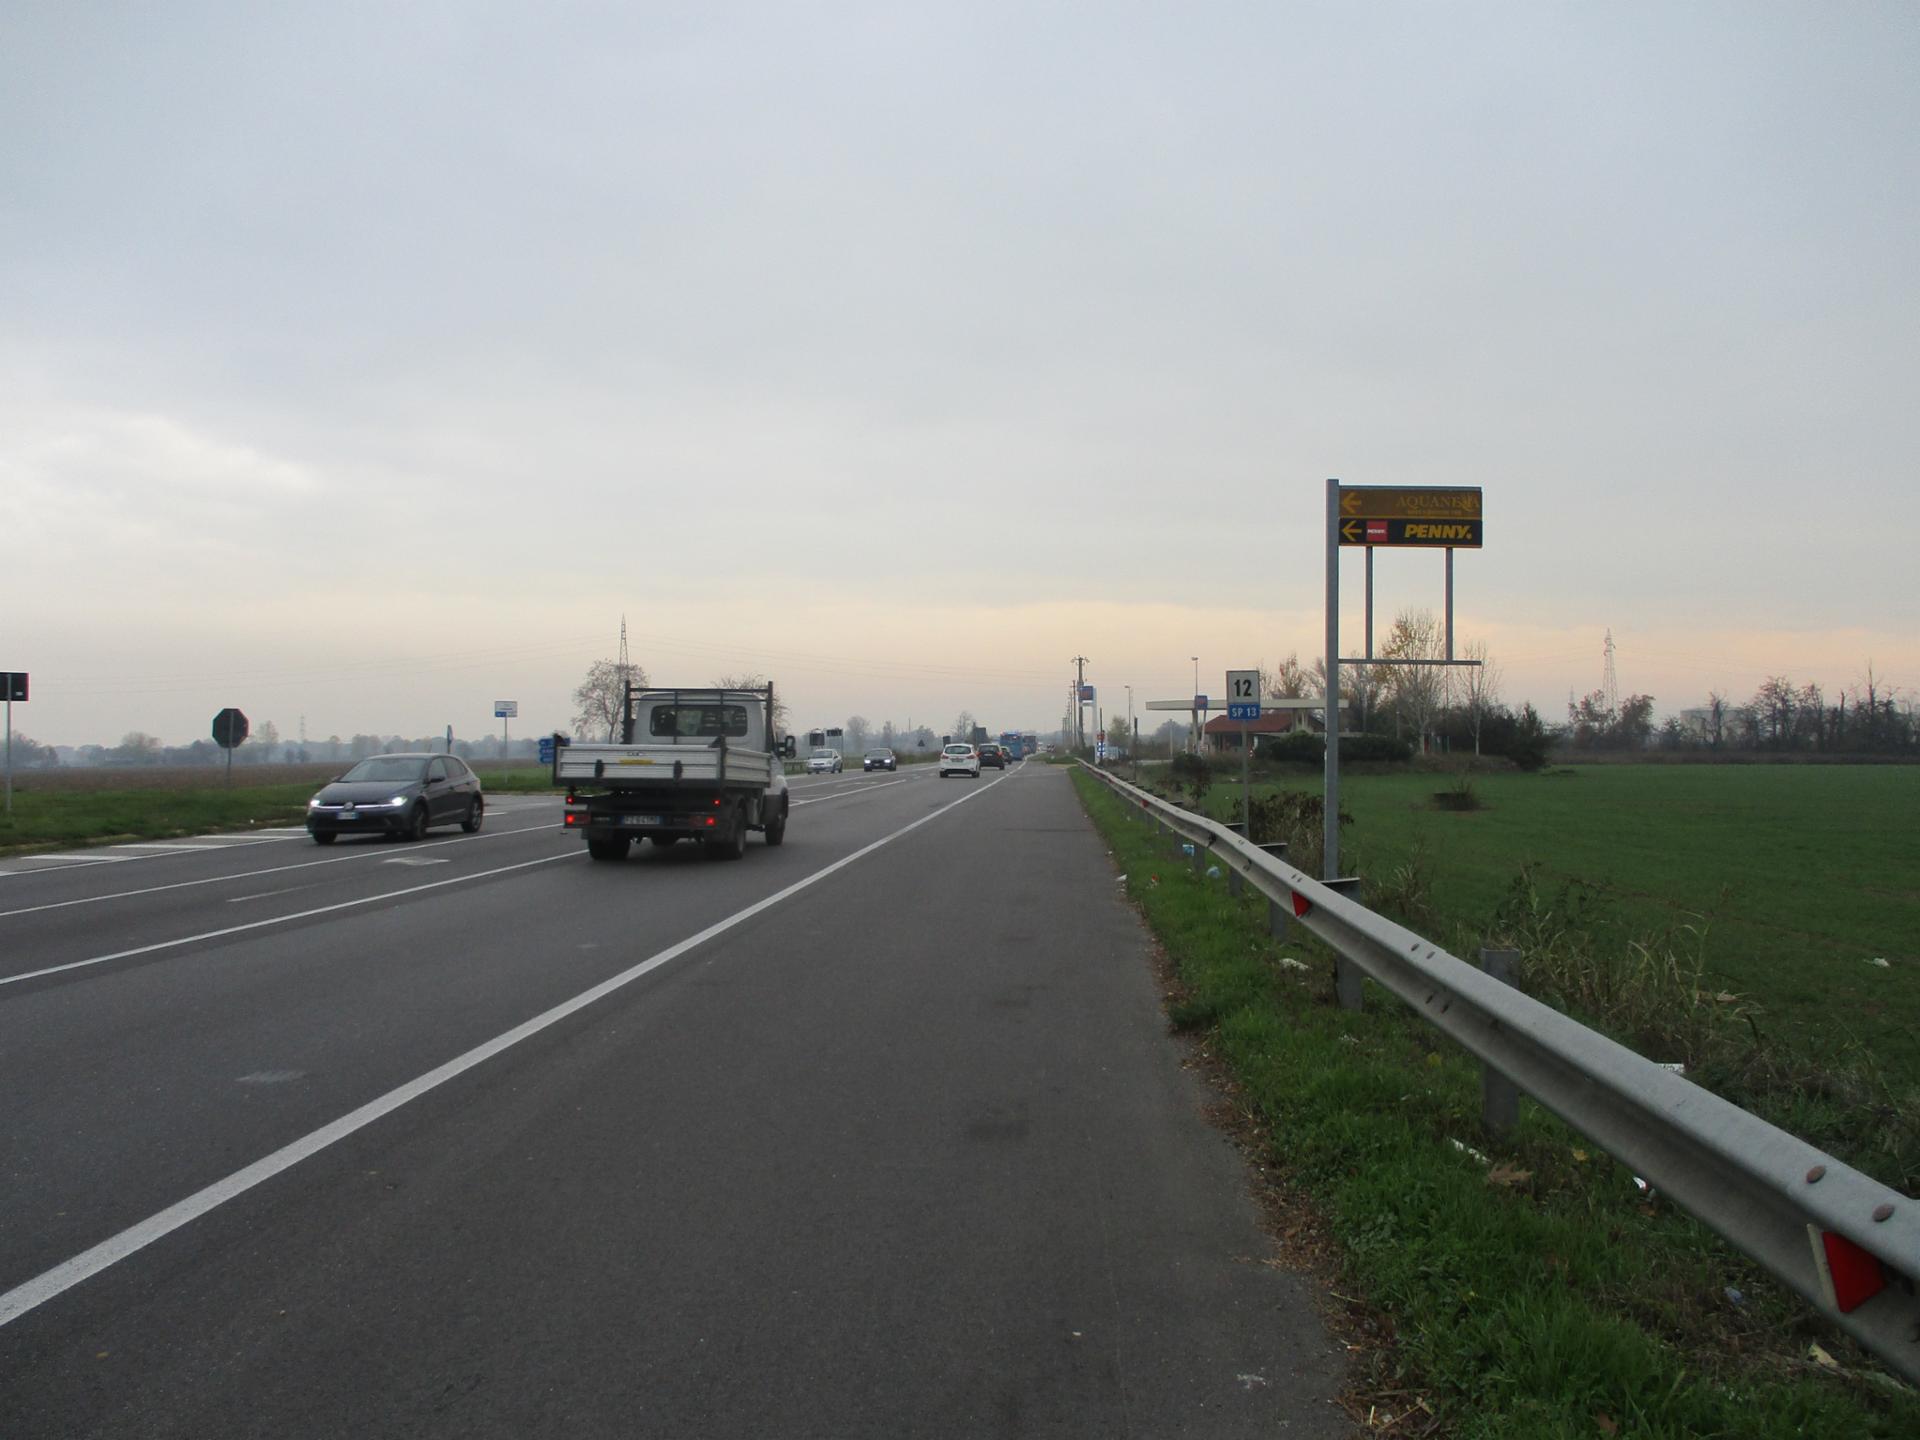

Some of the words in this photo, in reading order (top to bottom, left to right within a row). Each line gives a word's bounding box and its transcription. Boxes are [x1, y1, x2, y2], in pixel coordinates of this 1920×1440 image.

[1234, 679, 1252, 697] 12
[1231, 707, 1243, 717] SP
[1246, 706, 1257, 717] 13
